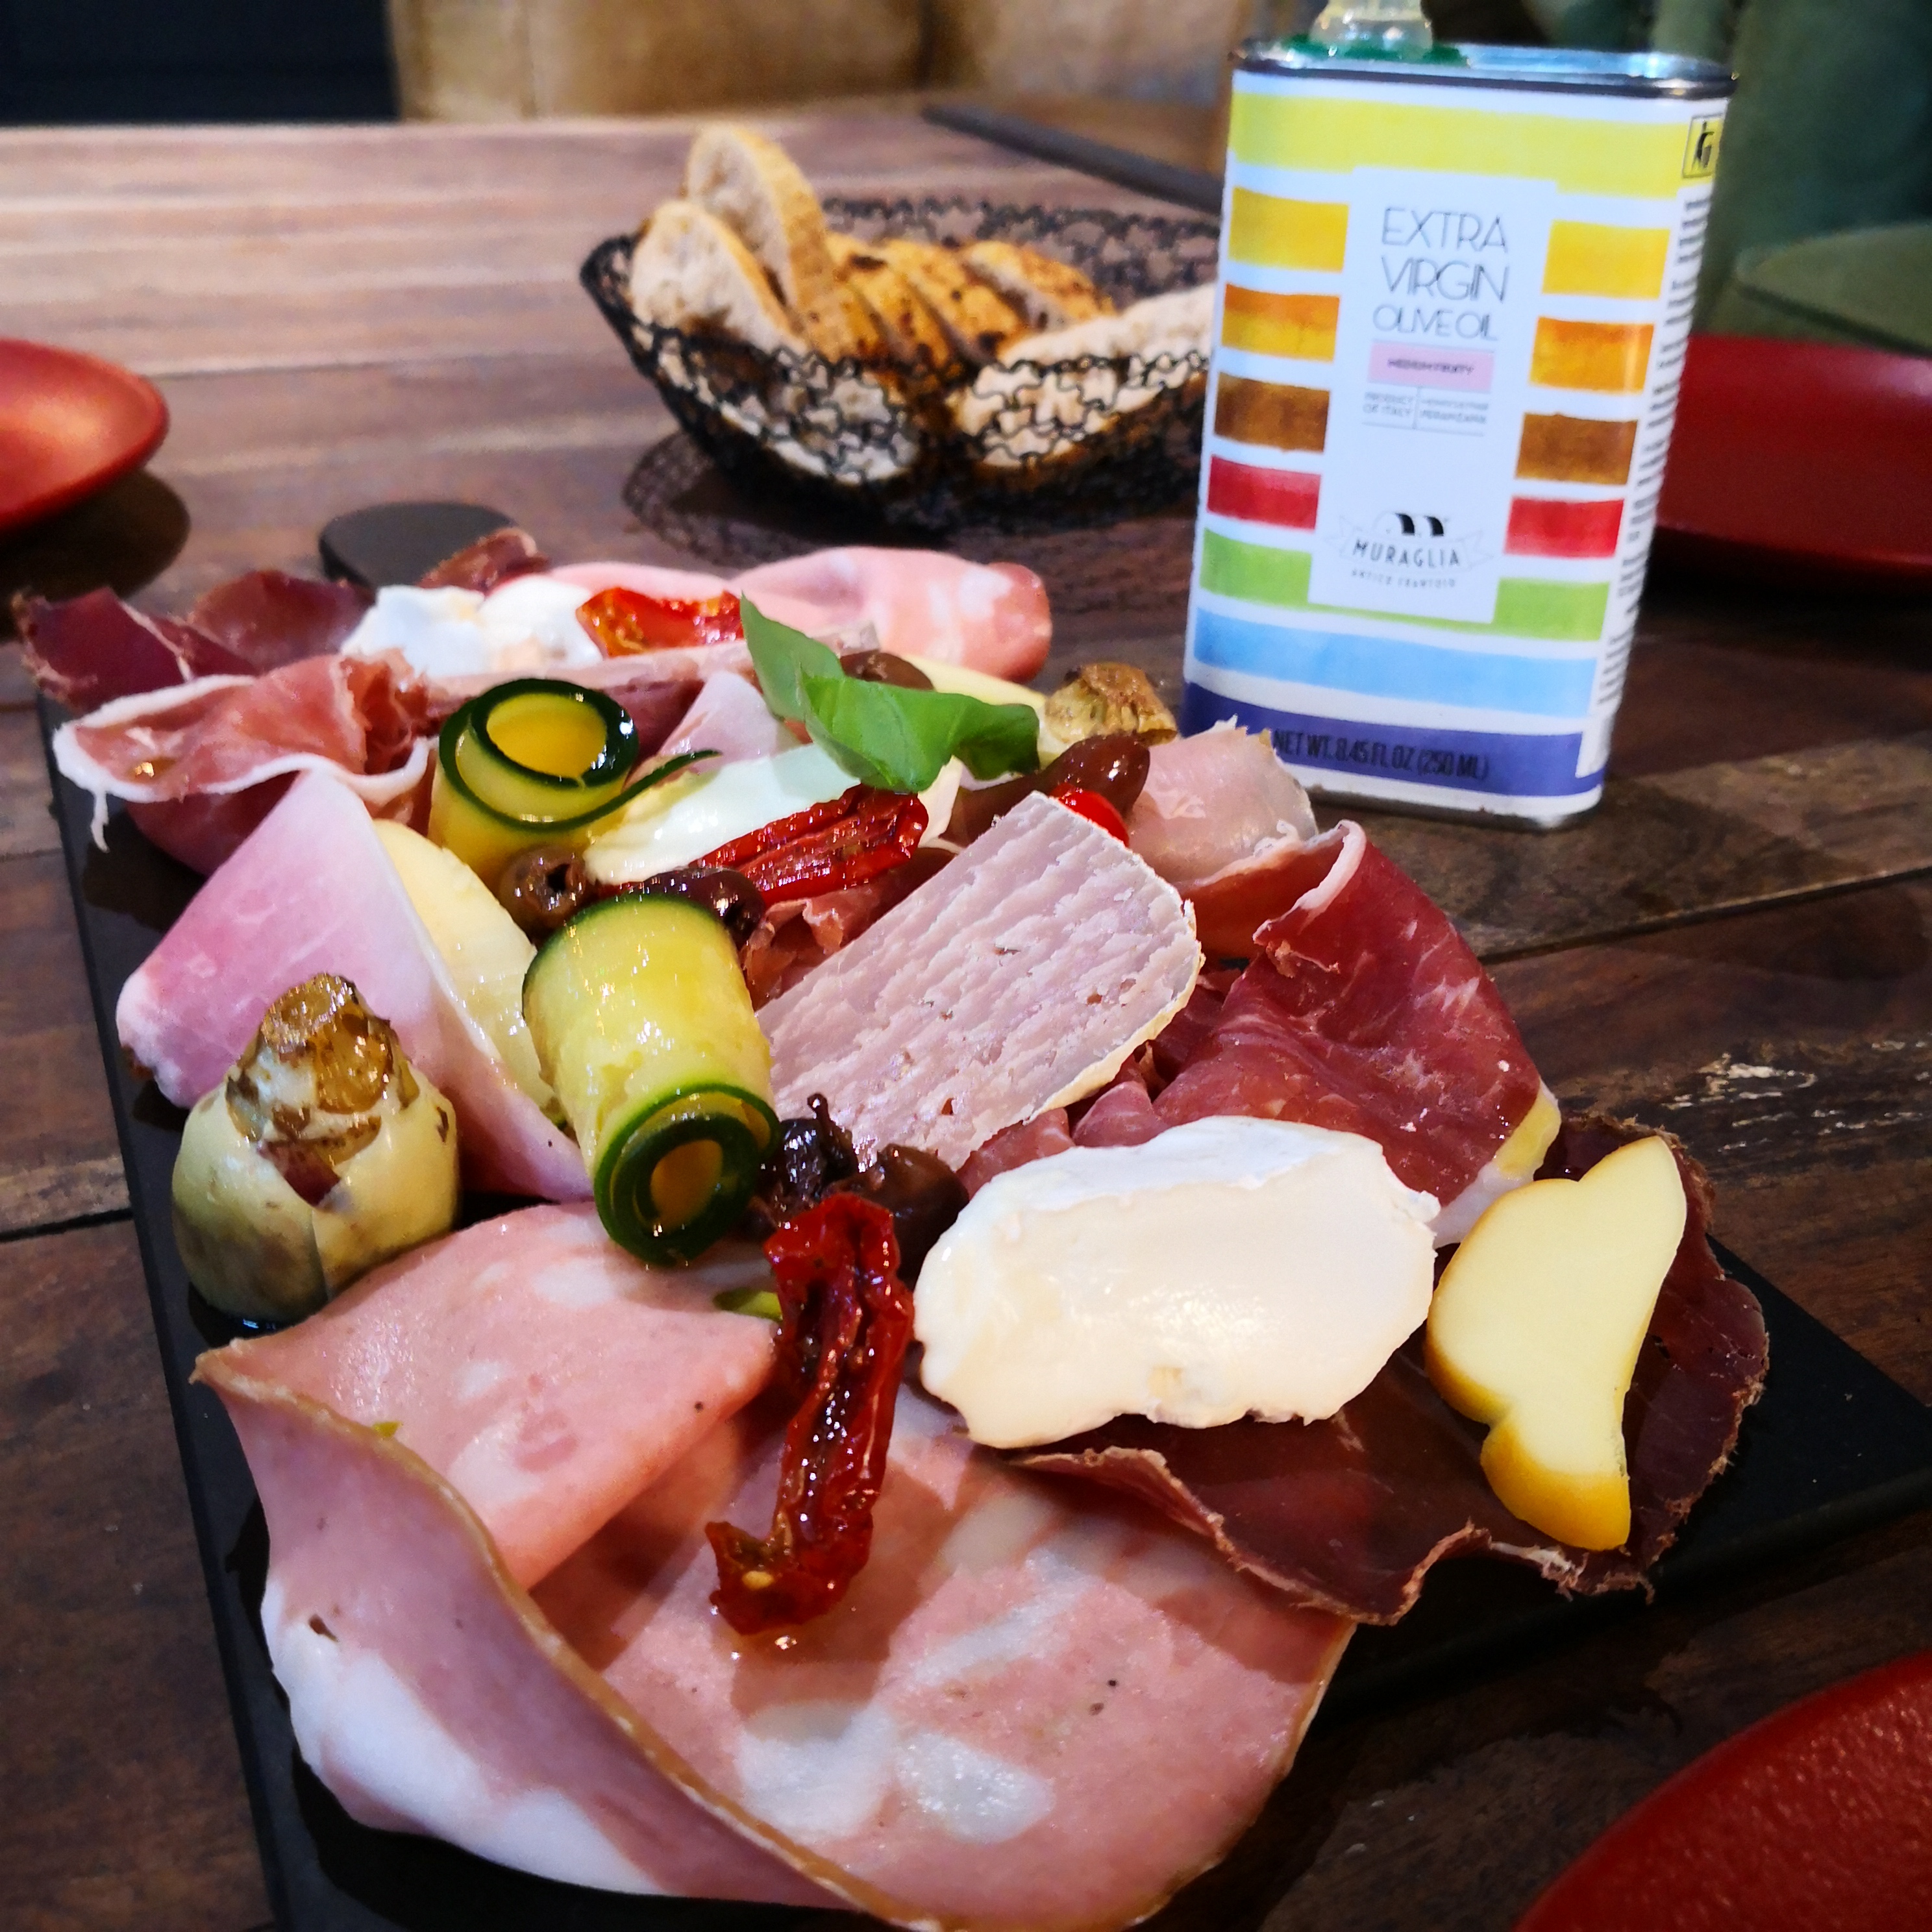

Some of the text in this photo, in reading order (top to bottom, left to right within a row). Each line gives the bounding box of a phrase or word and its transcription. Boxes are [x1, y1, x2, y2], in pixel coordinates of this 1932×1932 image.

[1381, 207, 1507, 253] EXTRA
[1381, 255, 1509, 303] VIRGIN
[1372, 303, 1498, 341] OLIVE OIL
[1352, 538, 1460, 568] MURAGLIA
[1273, 728, 1304, 756] NET
[1371, 741, 1389, 769] FL
[1393, 745, 1417, 772] OZ
[1456, 751, 1489, 780] ML)
